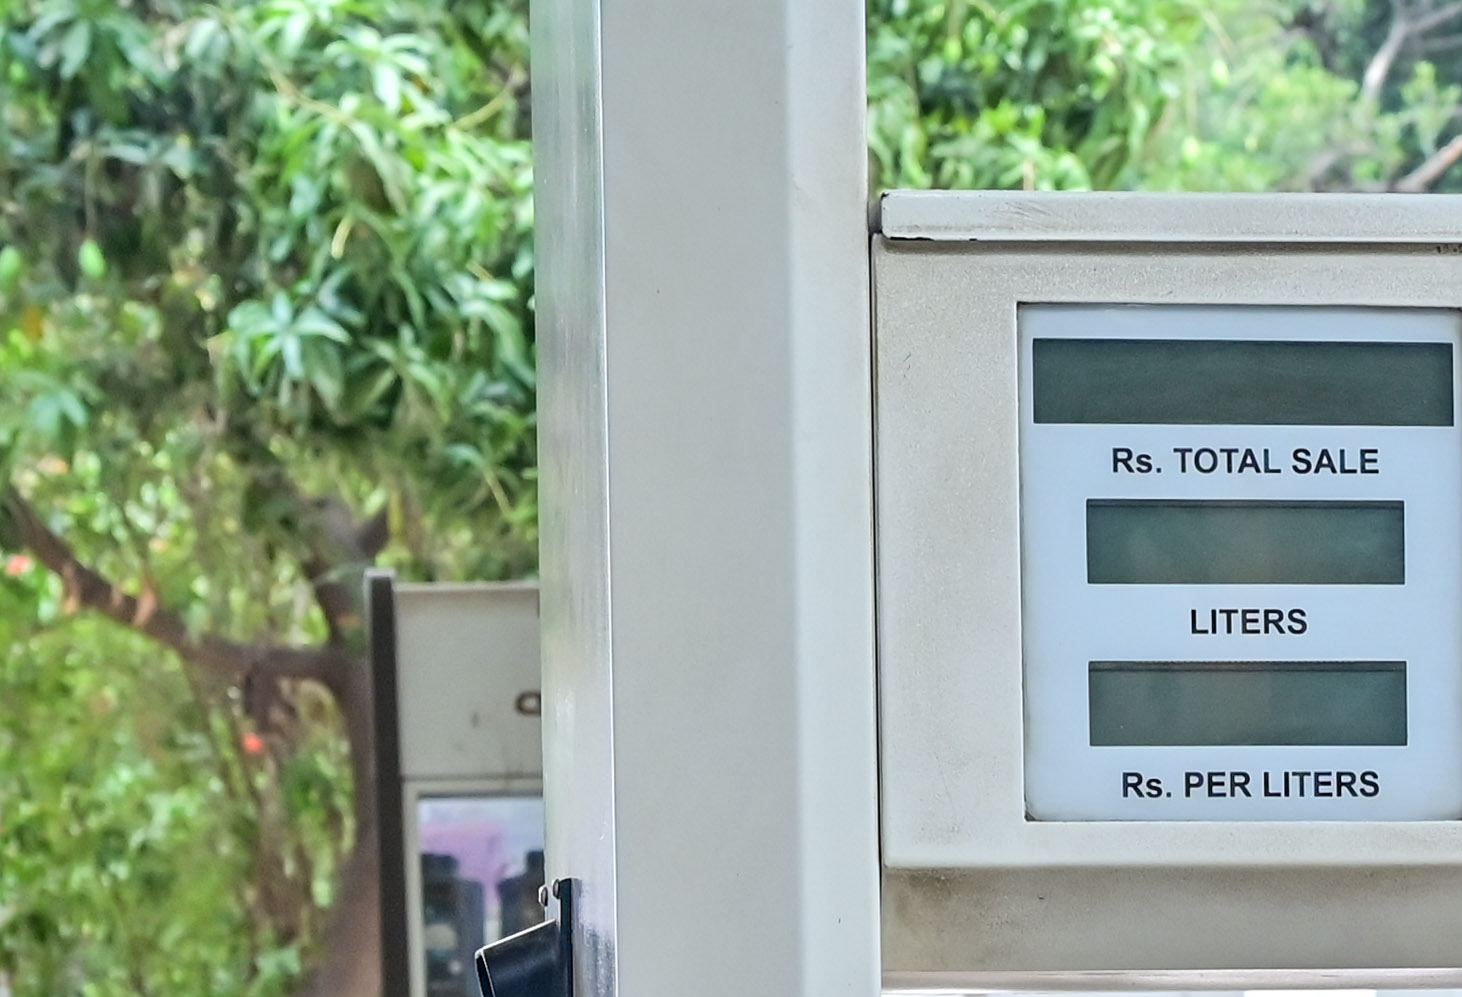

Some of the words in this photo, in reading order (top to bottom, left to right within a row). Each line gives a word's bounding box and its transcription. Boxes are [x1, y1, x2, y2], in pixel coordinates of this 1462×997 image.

[1112, 447, 1162, 474] Rs.
[1173, 447, 1282, 474] TOTAL
[1291, 448, 1380, 475] SALE
[1190, 608, 1308, 635] LITERS
[1122, 772, 1172, 799] Rs.
[1184, 771, 1252, 798] PER
[1263, 770, 1380, 798] LITERS
